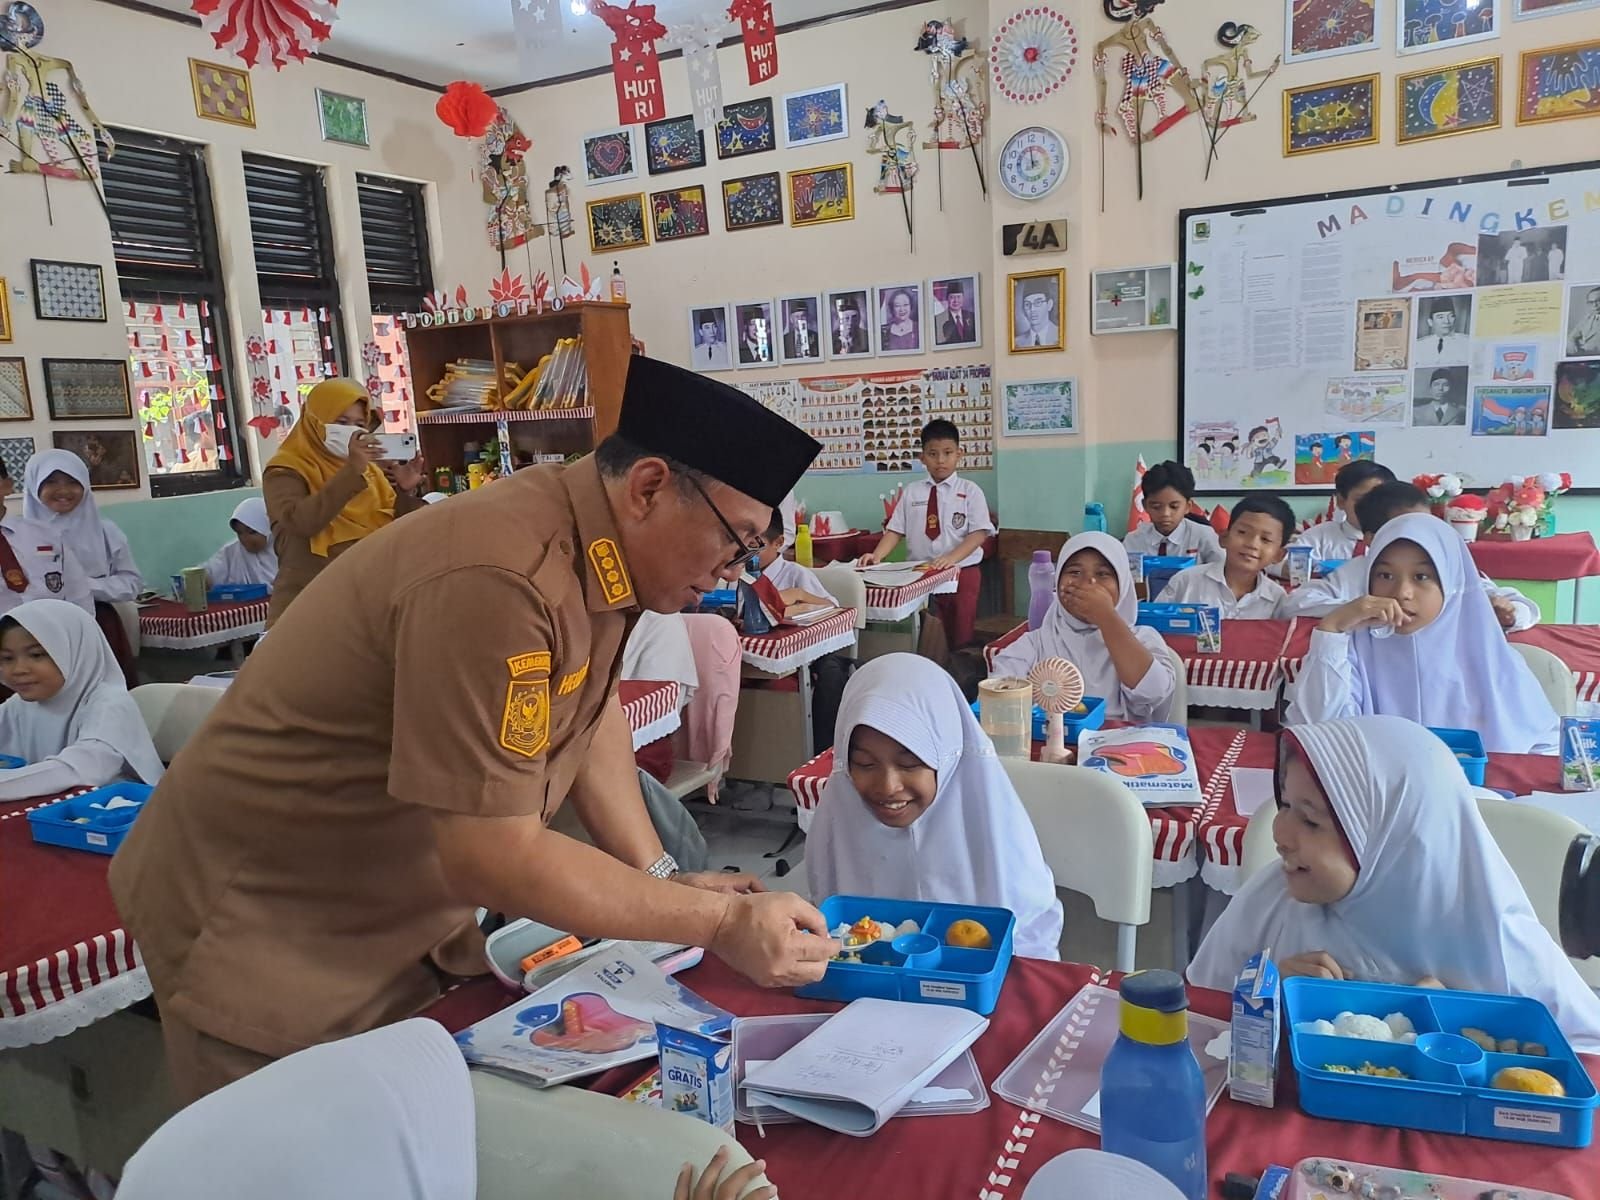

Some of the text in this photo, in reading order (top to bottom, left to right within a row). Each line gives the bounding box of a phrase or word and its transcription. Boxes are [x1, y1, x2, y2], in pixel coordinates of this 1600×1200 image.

[750, 42, 773, 63] HUT
[759, 61, 771, 79] RI
[623, 79, 656, 100] HUT
[696, 86, 718, 106] HUT
[635, 100, 654, 120] RI
[703, 107, 717, 125] RI
[1027, 134, 1036, 143] 12
[1042, 136, 1046, 144] 1
[1017, 140, 1023, 149] 11
[1050, 144, 1056, 152] 2
[1008, 150, 1017, 159] 10
[1053, 155, 1060, 164] 3
[1006, 163, 1013, 171] 9
[1050, 169, 1056, 177] 4
[1010, 175, 1017, 184] 8
[1042, 179, 1049, 188] 5
[1018, 183, 1025, 191] 7
[1031, 185, 1037, 193] 6
[1022, 223, 1060, 250] 4A
[1122, 781, 1193, 789] Matematik
[667, 1069, 703, 1090] GRATIS
